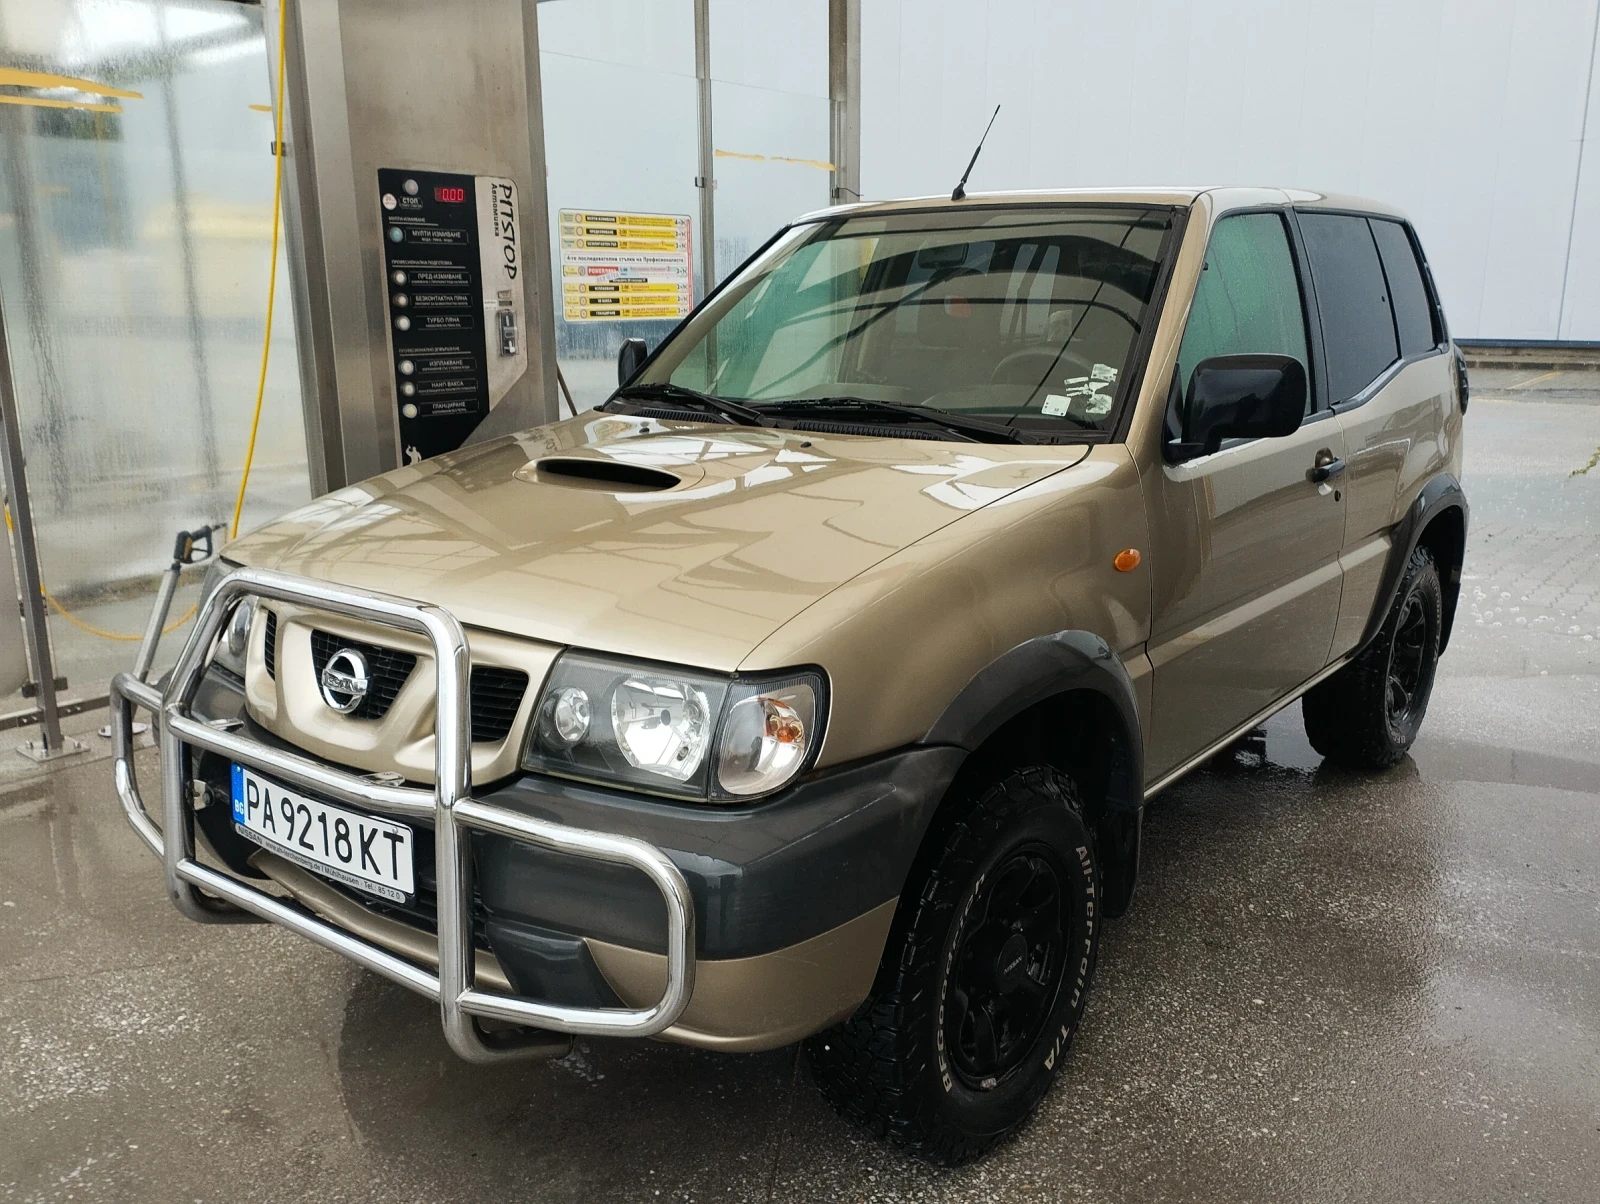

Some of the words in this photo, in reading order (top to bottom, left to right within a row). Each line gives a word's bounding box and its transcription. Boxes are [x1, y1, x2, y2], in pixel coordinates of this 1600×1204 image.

[498, 184, 518, 280] PITSTOP
[234, 800, 244, 814] BG
[246, 778, 404, 880] PA9218KT
[238, 826, 263, 845] NISSAN
[324, 866, 360, 886] Mühlhausen
[1071, 846, 1095, 1008] All-Terrain
[1044, 1025, 1070, 1070] T/A
